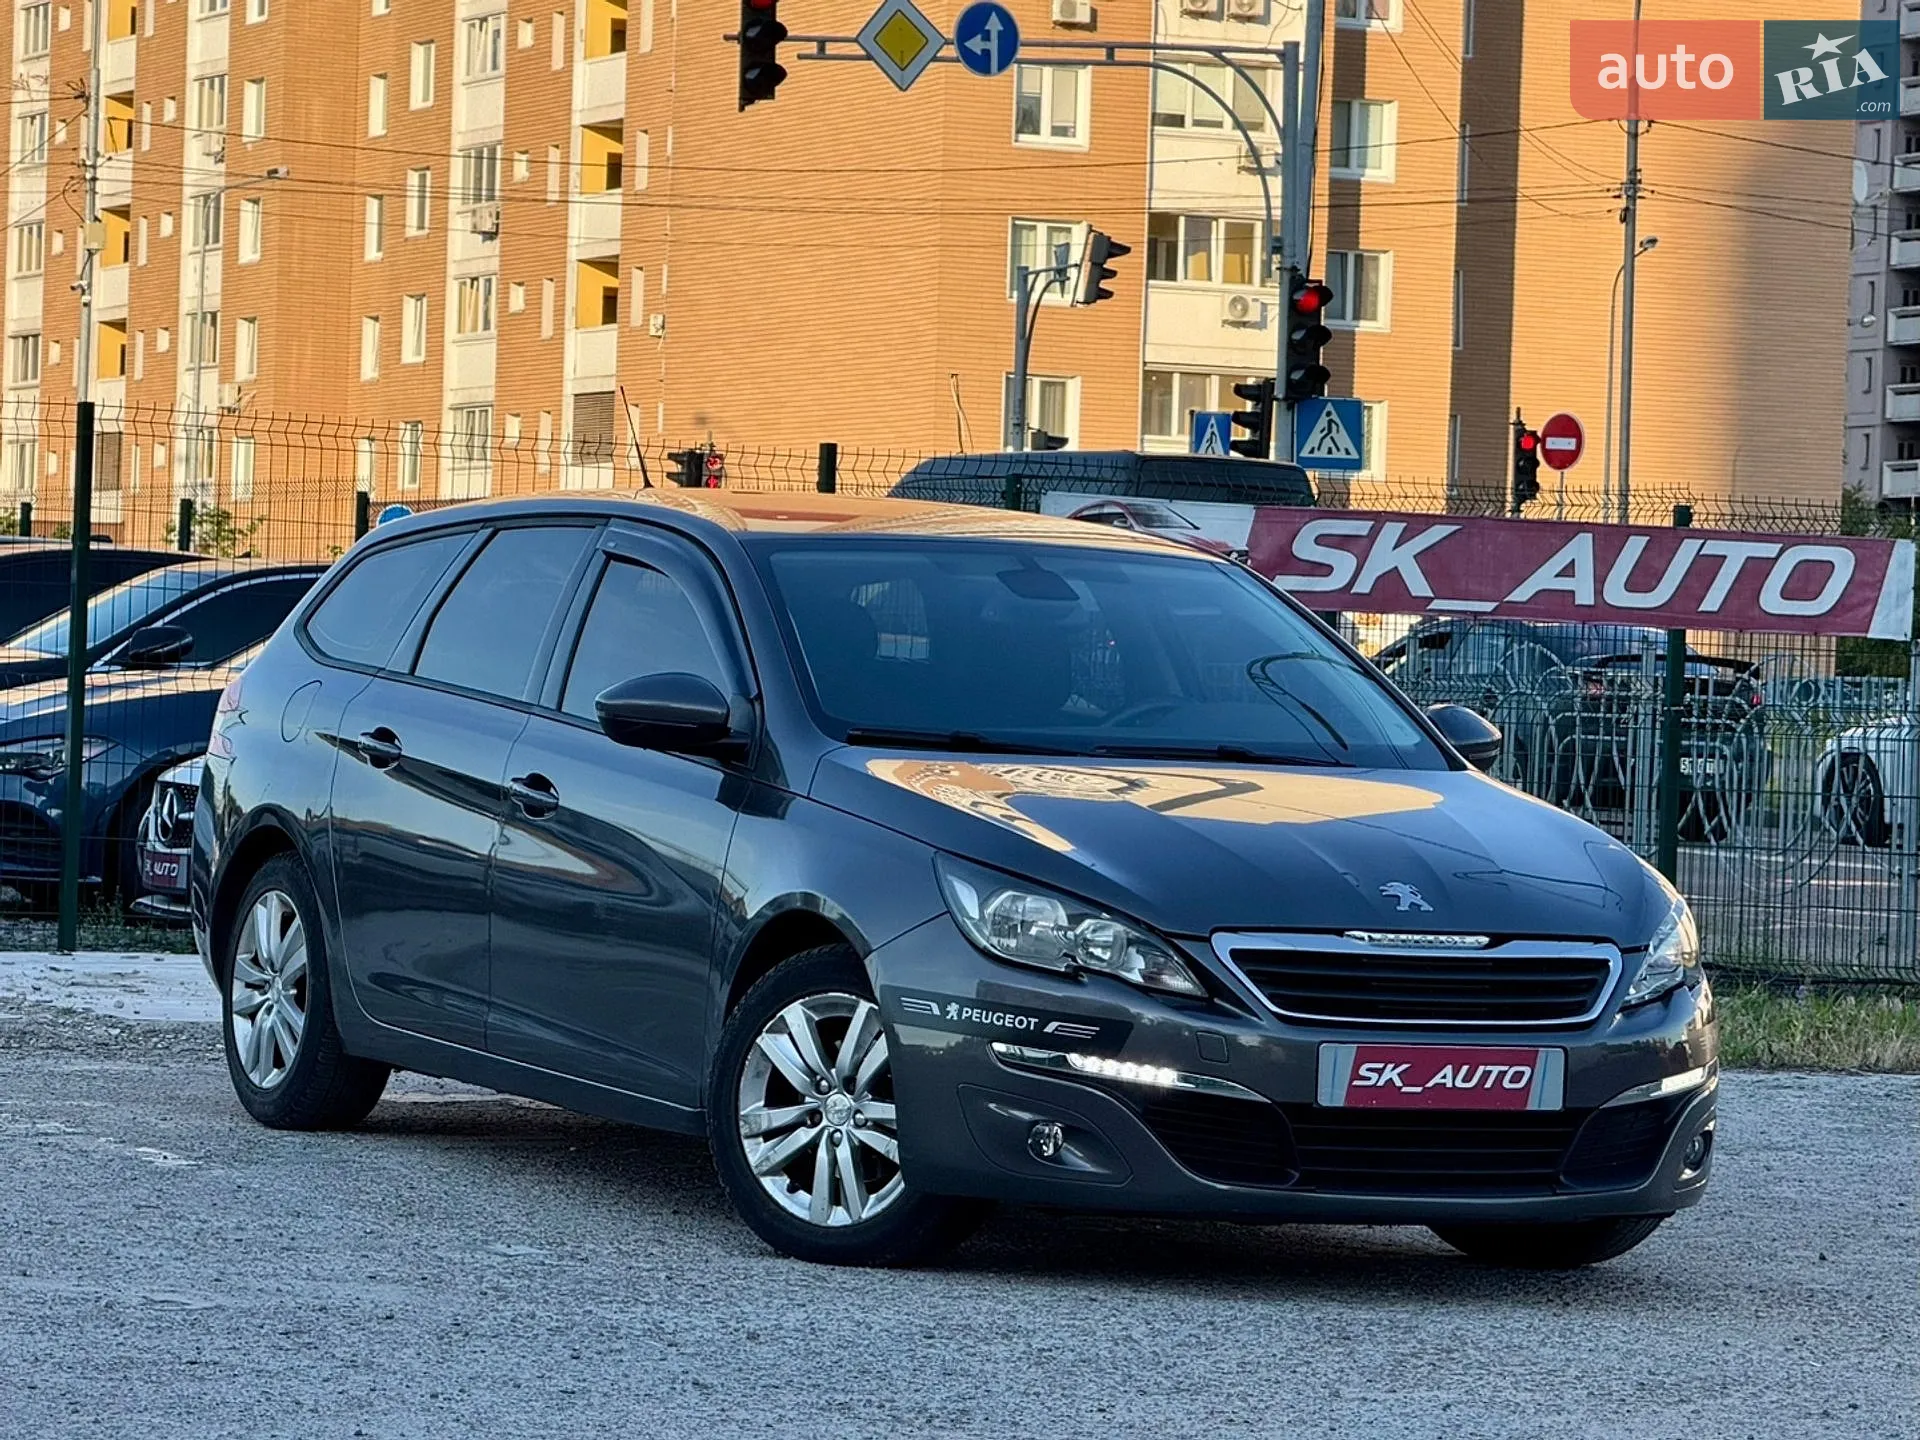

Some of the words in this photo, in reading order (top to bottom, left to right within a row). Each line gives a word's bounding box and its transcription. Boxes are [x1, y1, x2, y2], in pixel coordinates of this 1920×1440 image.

[1272, 518, 1856, 617] SK_AUTO
[961, 1007, 1039, 1031] PEUGEOT
[1351, 1062, 1533, 1093] SK_AUTO
